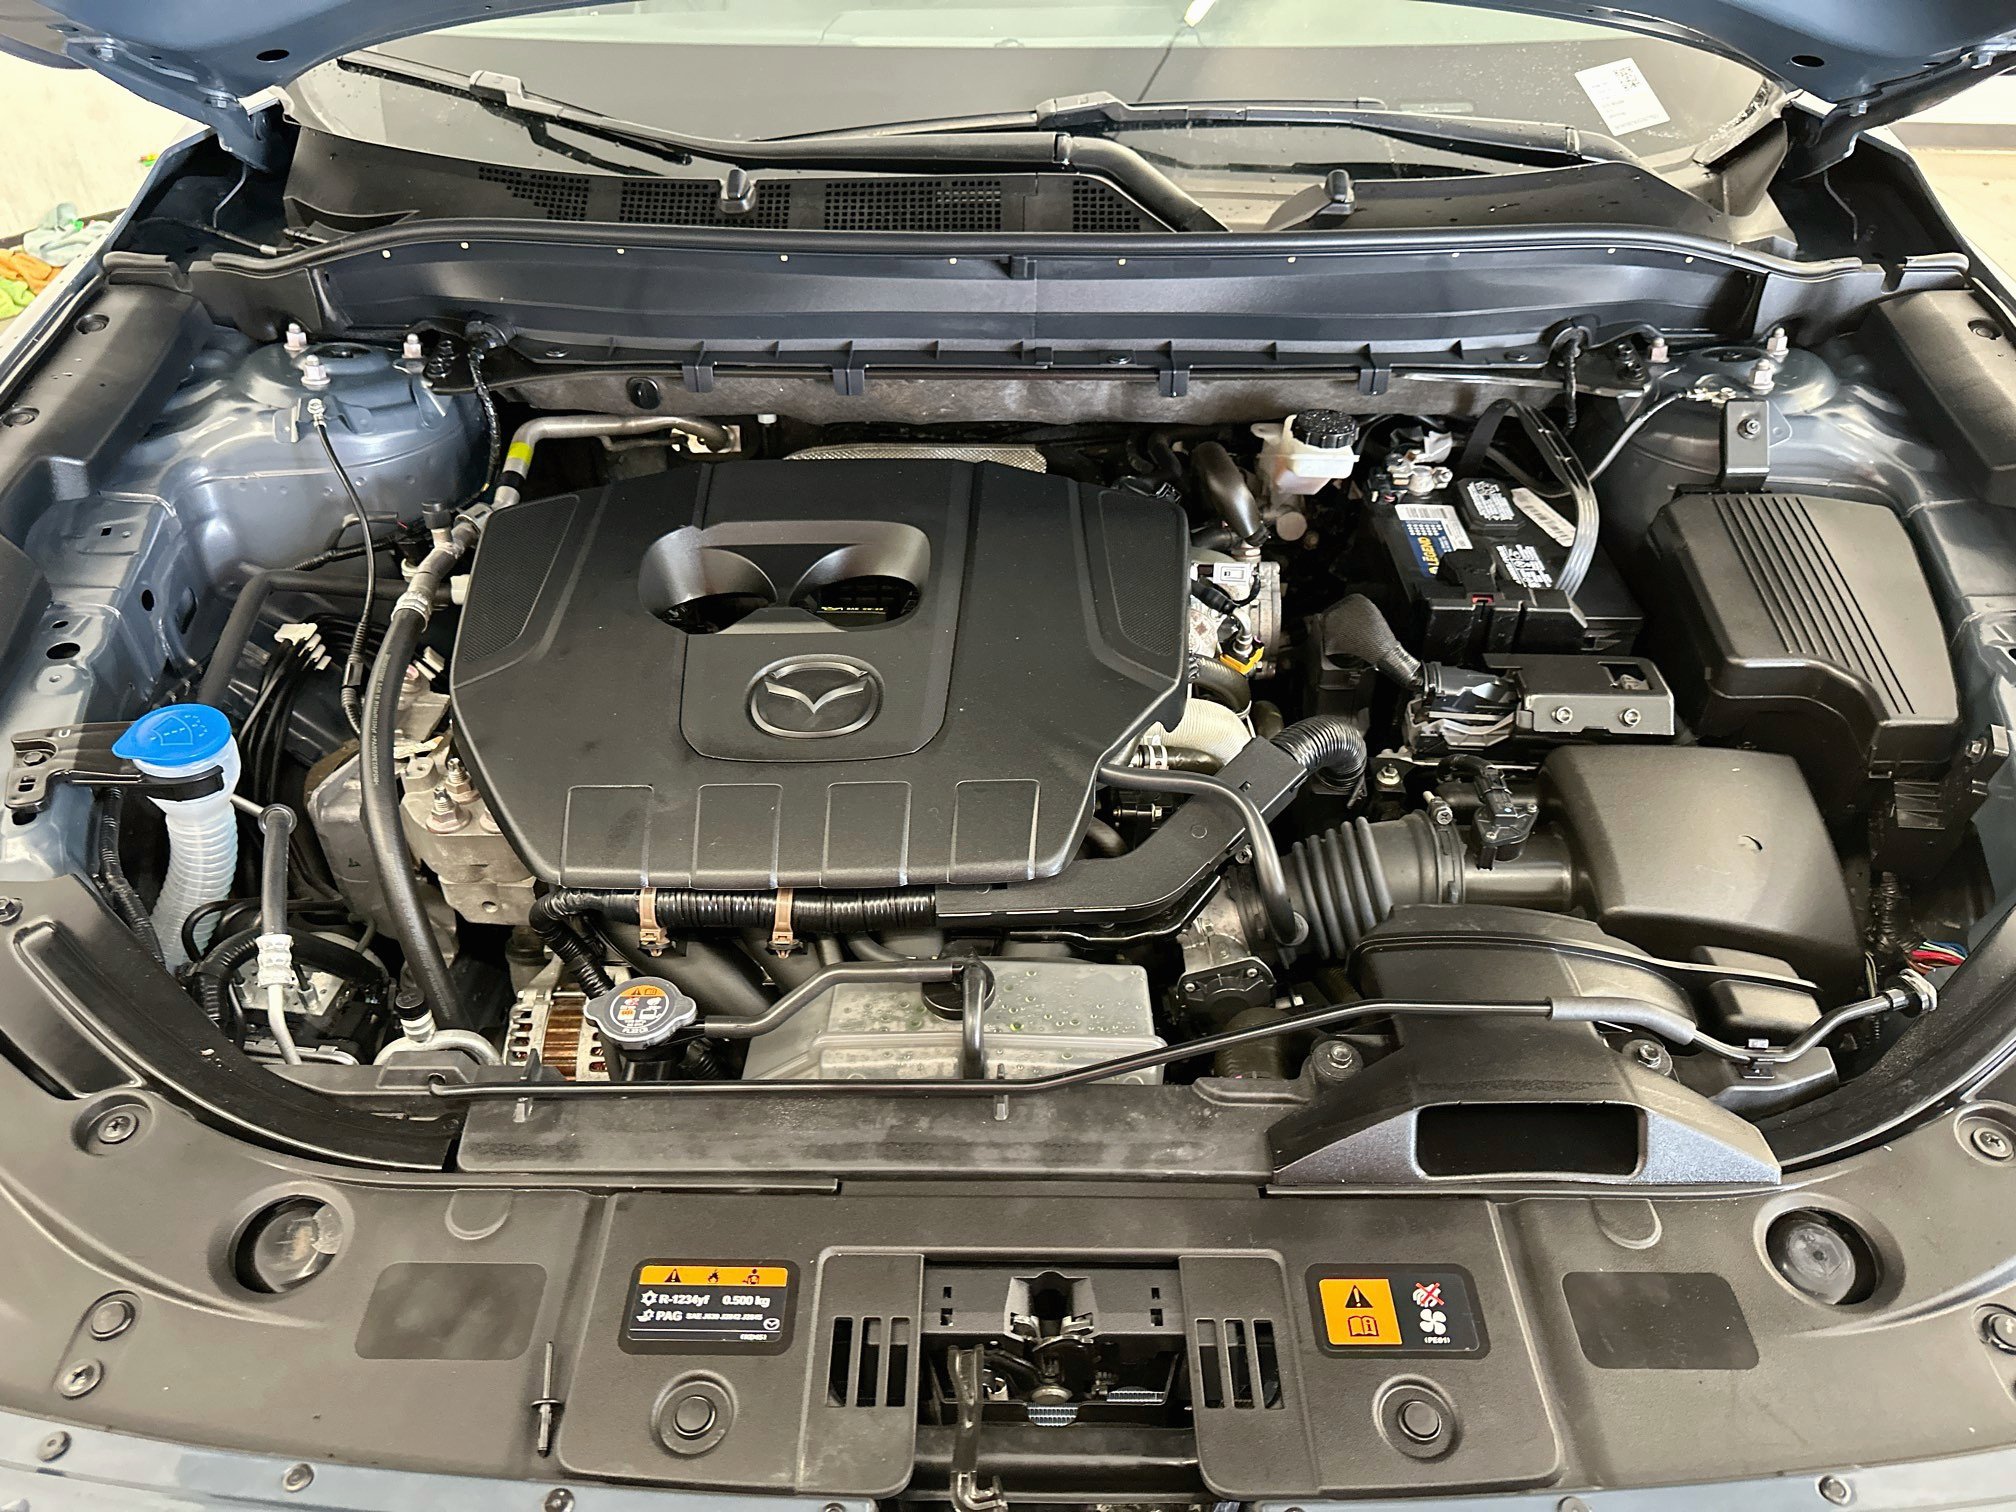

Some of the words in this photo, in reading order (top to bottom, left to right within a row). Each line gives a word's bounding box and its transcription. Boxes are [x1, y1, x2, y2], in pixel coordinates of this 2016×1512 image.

[658, 1294, 711, 1307] R-1234yf
[721, 1295, 754, 1306] 0.500
[754, 1295, 771, 1308] kg
[655, 1310, 683, 1322] PAG
